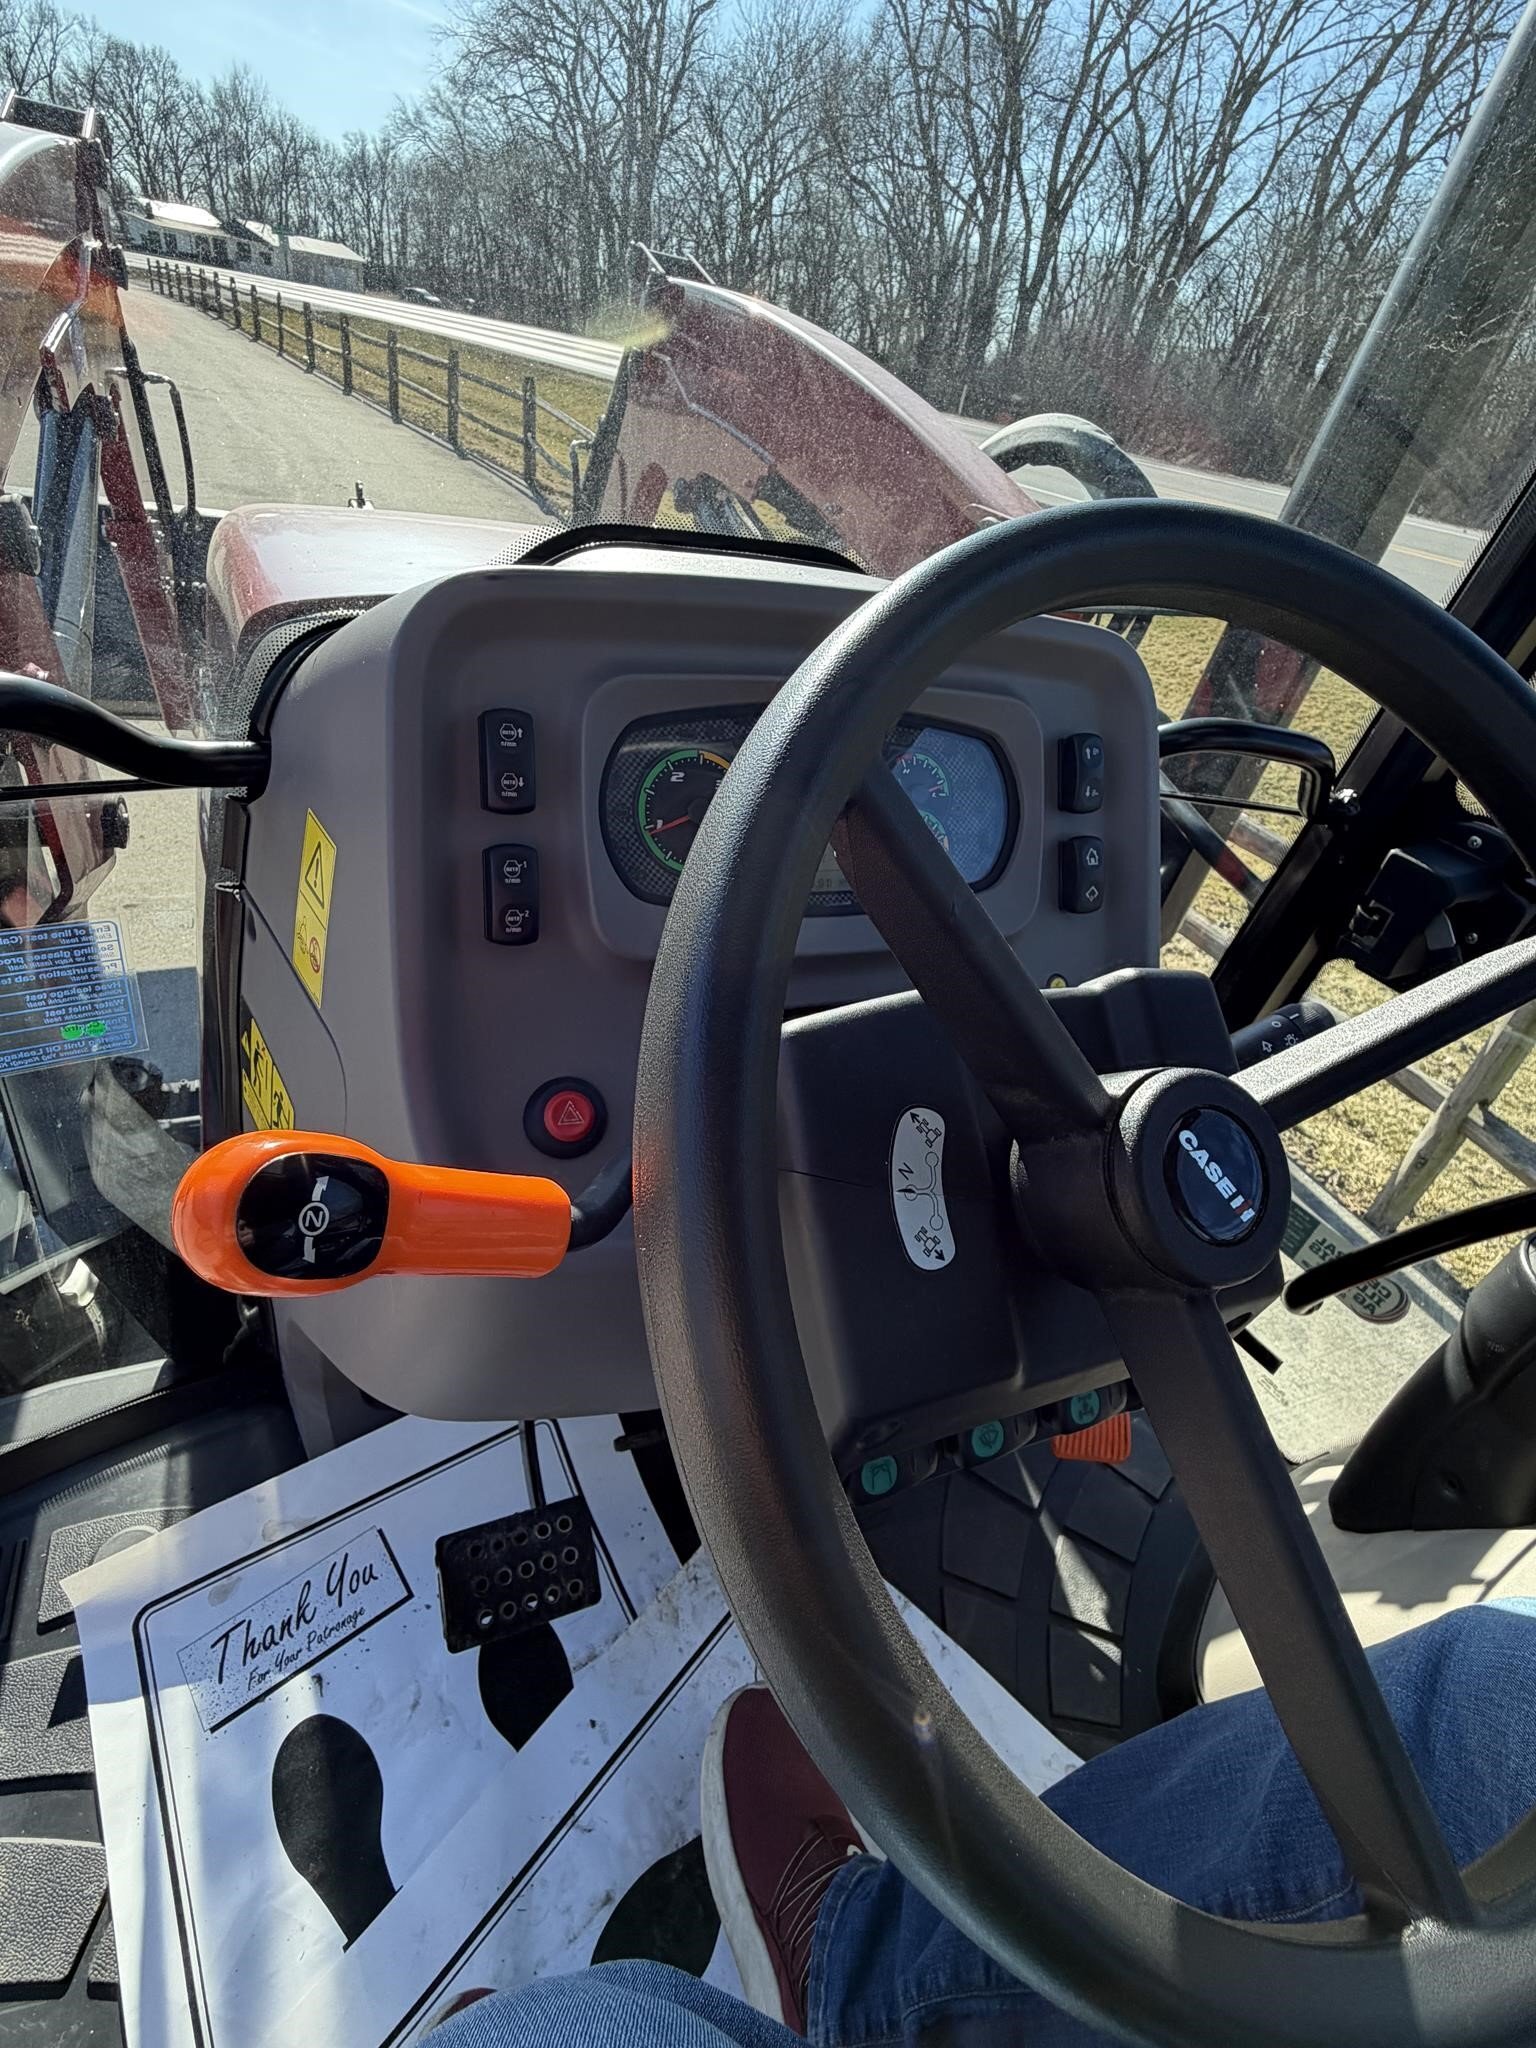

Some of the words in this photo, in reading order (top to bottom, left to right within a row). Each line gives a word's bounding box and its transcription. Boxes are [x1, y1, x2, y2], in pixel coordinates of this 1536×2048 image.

[670, 771, 685, 782] 2
[898, 1162, 914, 1180] N
[1178, 1129, 1237, 1199] CASE
[305, 1210, 323, 1228] N
[210, 1580, 317, 1684] Thank
[326, 1552, 378, 1608] You
[248, 1666, 270, 1691] For
[275, 1648, 302, 1672] Your
[307, 1606, 366, 1651] Patronage
